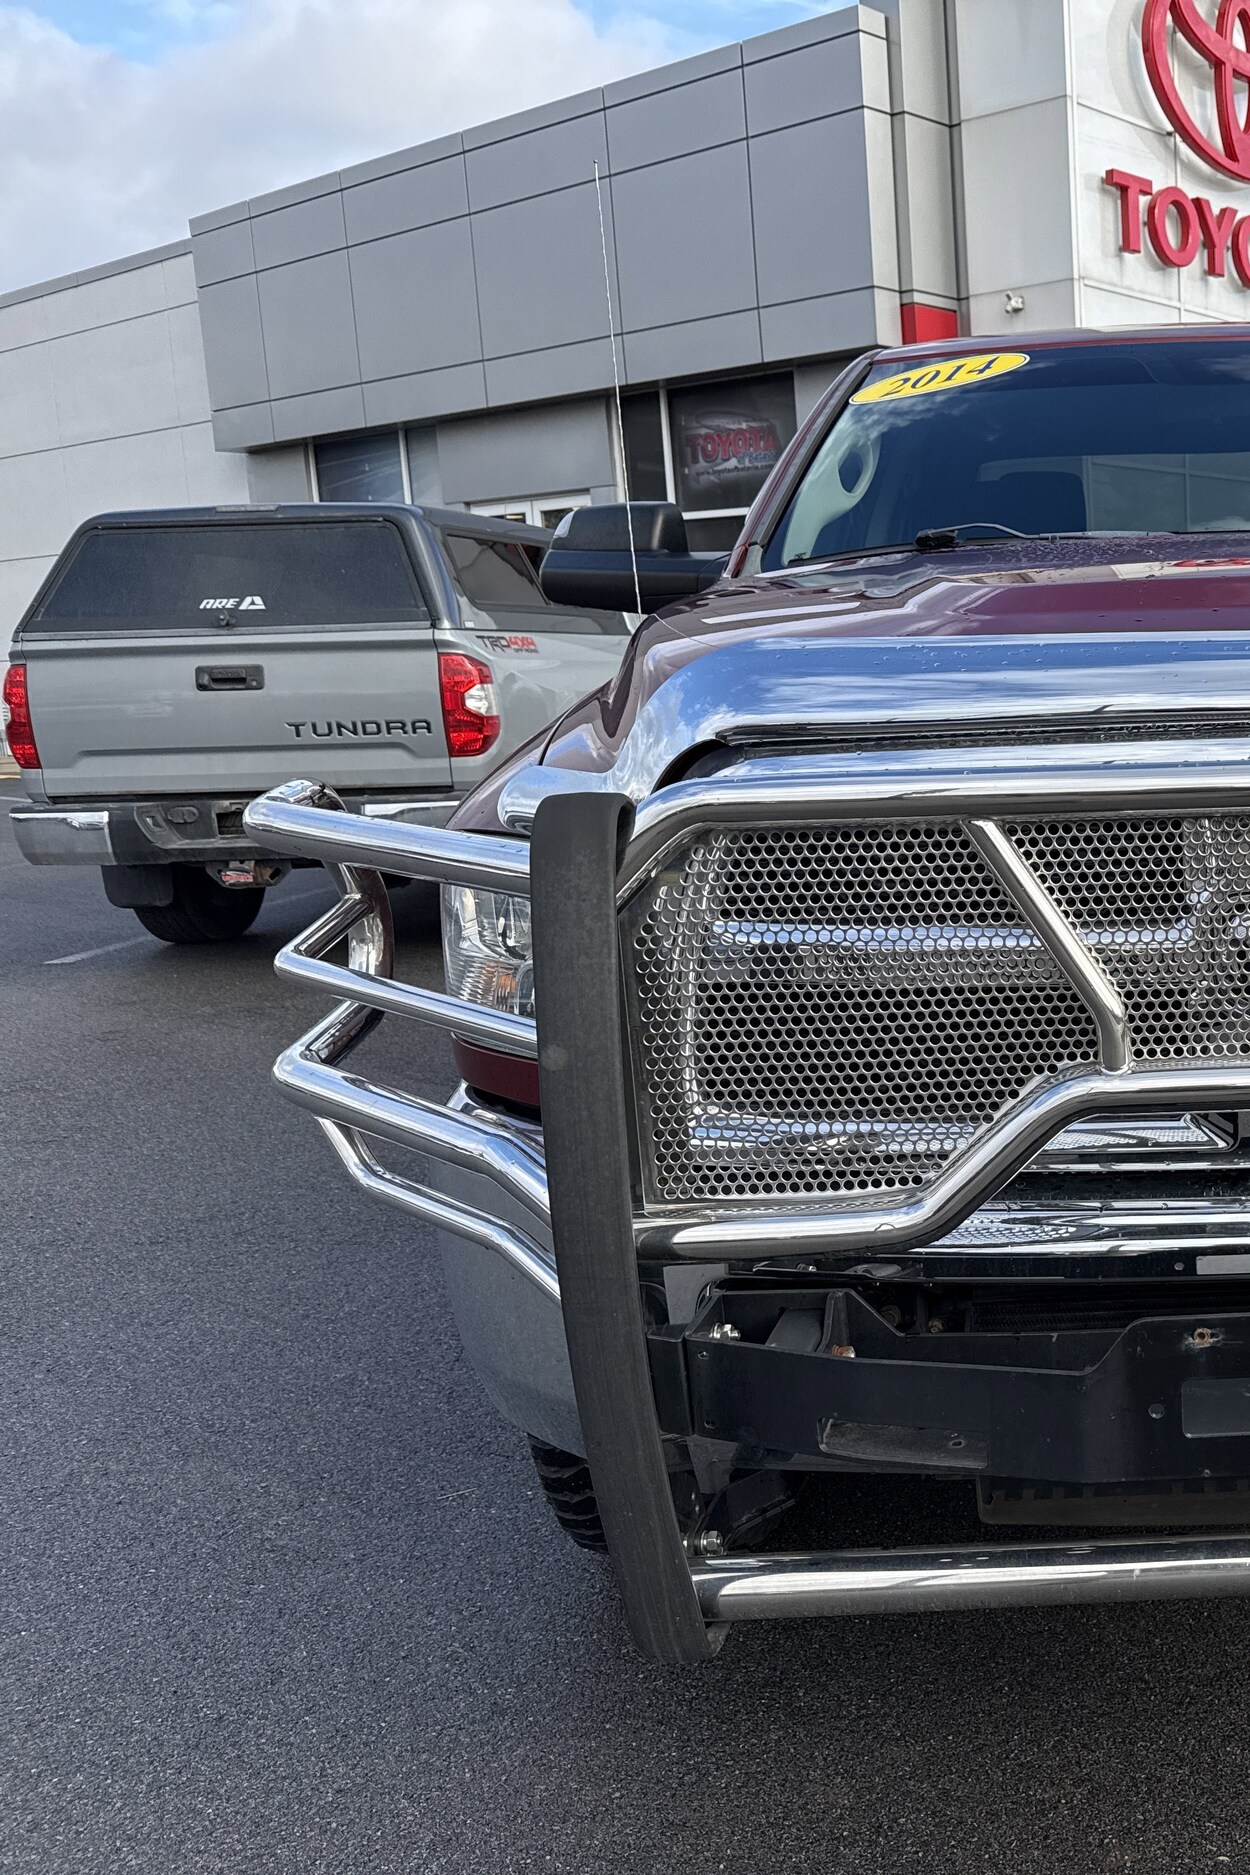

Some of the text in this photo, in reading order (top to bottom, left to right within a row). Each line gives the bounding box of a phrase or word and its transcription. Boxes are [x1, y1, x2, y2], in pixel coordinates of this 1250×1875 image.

[879, 356, 1001, 398] 2014
[687, 424, 780, 464] TOYOTA
[199, 598, 240, 609] ARE
[475, 634, 511, 653] TRD
[285, 718, 434, 739] TUNDRA
